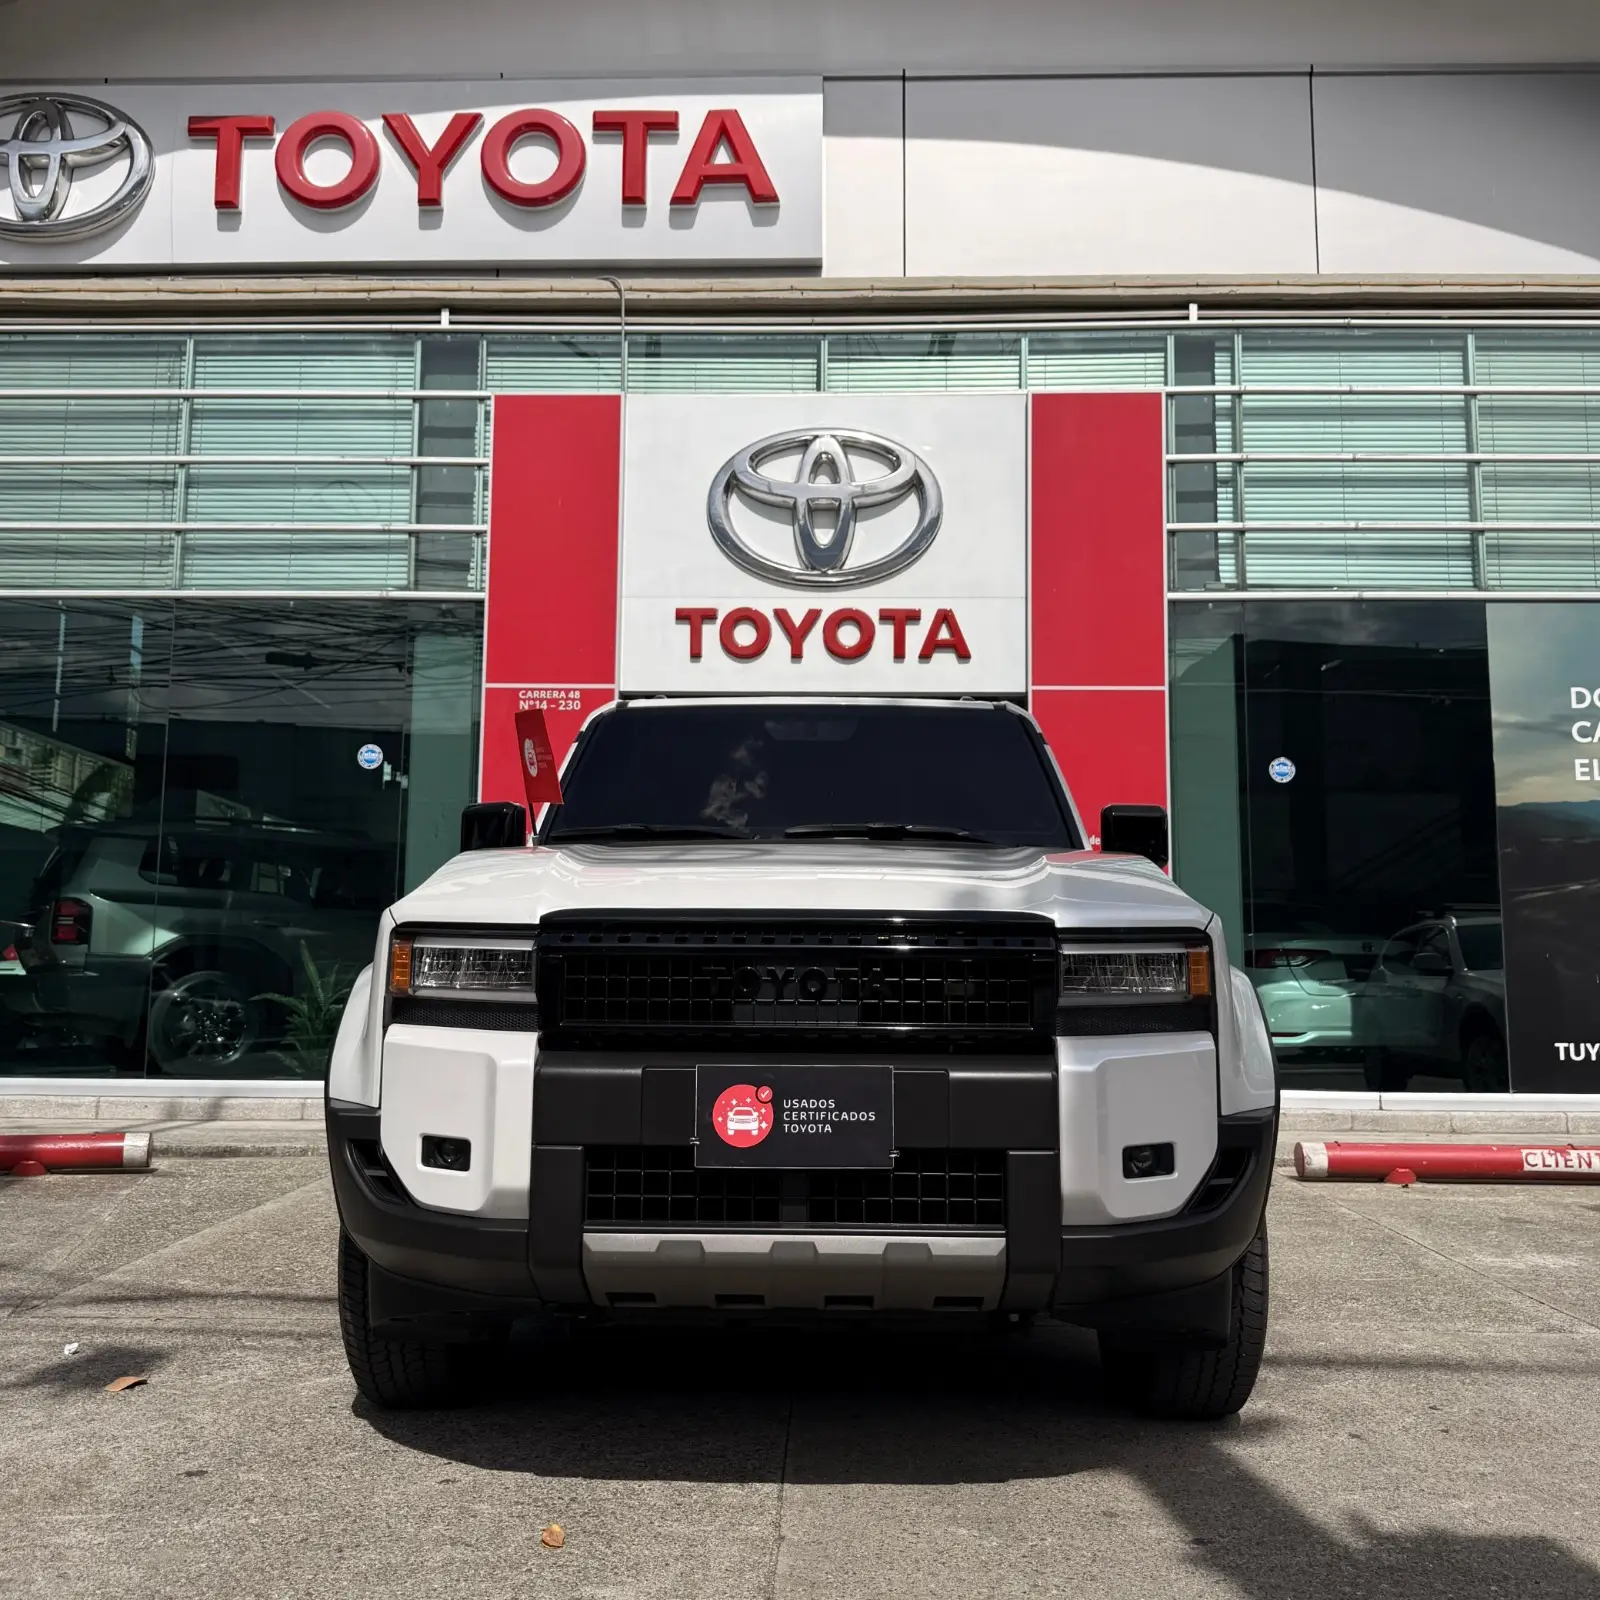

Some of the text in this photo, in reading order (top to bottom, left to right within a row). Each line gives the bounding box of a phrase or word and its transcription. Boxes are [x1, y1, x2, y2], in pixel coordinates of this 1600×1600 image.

[188, 108, 780, 211] TOYOTA
[675, 606, 972, 661] TOYOTA
[518, 690, 580, 699] CARRERA 48
[558, 700, 581, 710] 230
[701, 965, 892, 1001] TOYOTA
[783, 1099, 835, 1109] USADOS
[783, 1111, 876, 1121] CERTIFICADOS
[783, 1123, 832, 1133] TOYOTA
